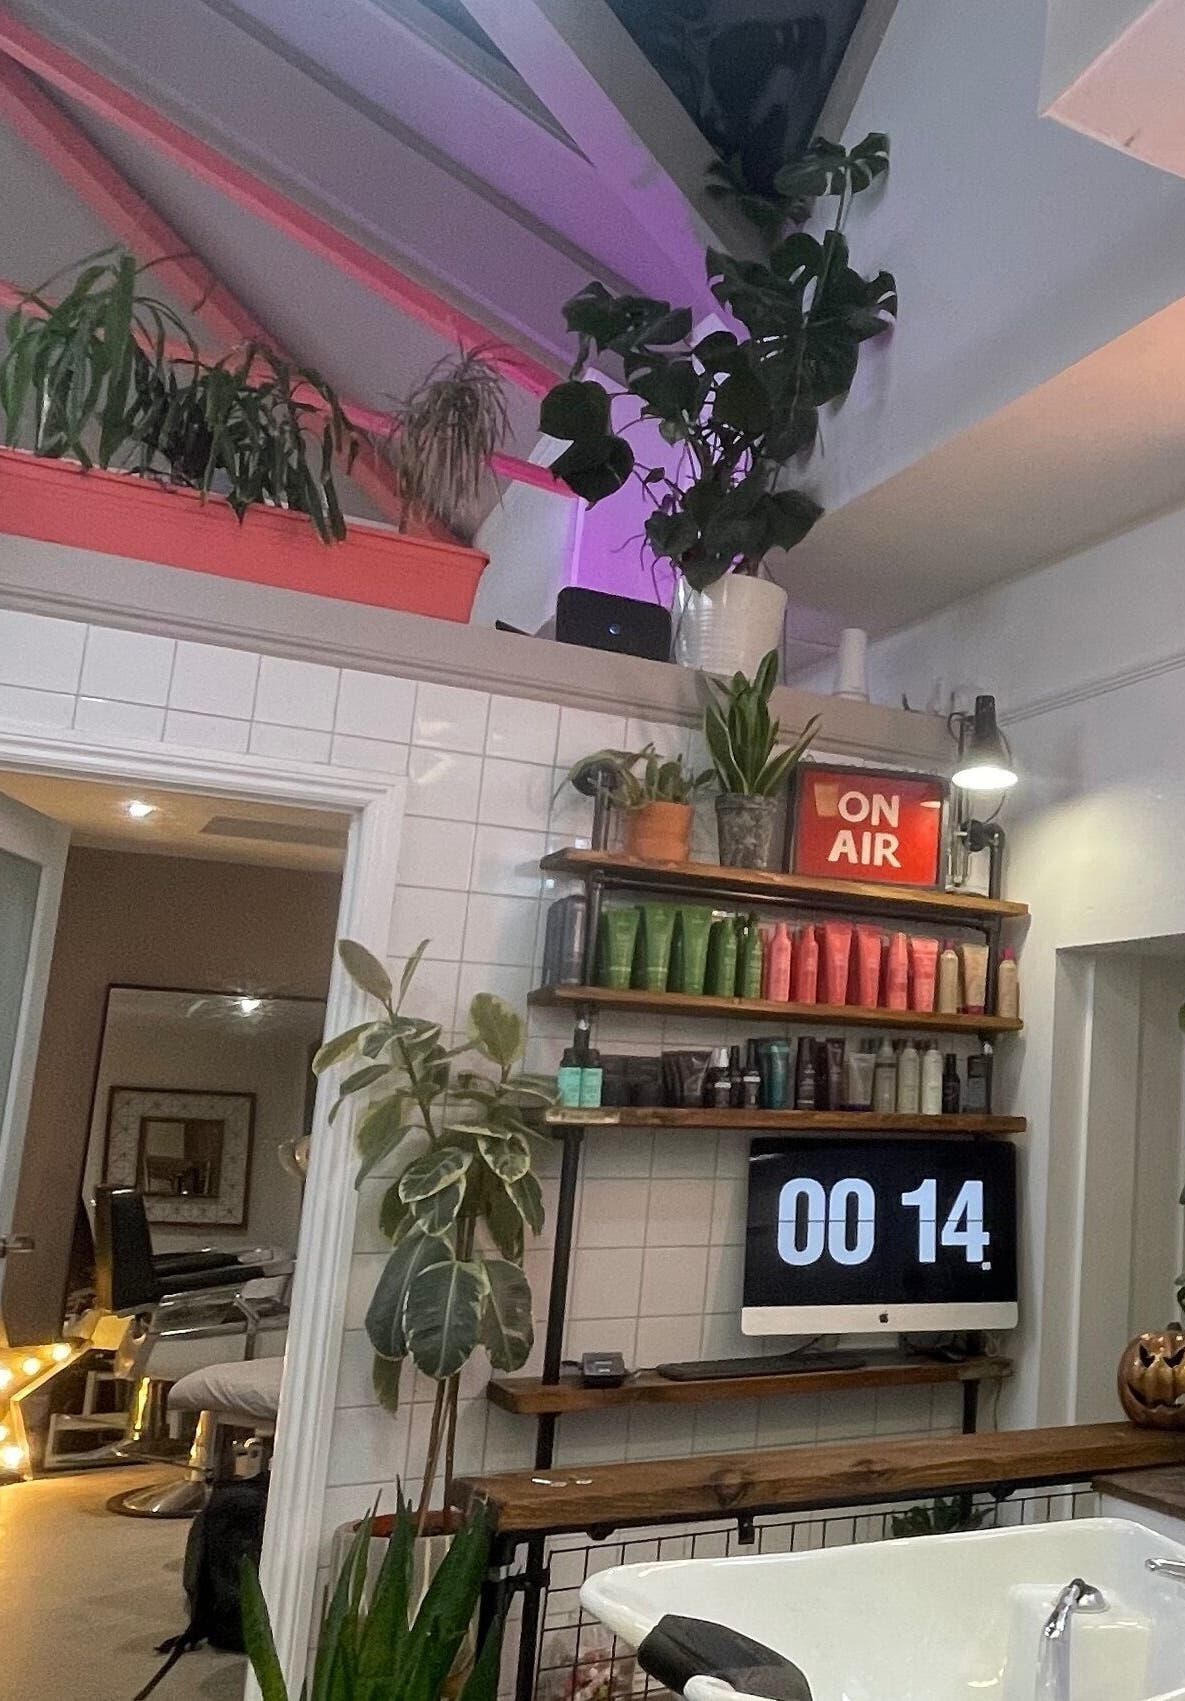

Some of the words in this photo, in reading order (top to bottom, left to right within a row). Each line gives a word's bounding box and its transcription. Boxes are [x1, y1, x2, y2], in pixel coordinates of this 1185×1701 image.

[838, 791, 900, 828] ON
[828, 829, 902, 868] AIR
[777, 1177, 876, 1267] 00
[901, 1178, 990, 1264] 14
